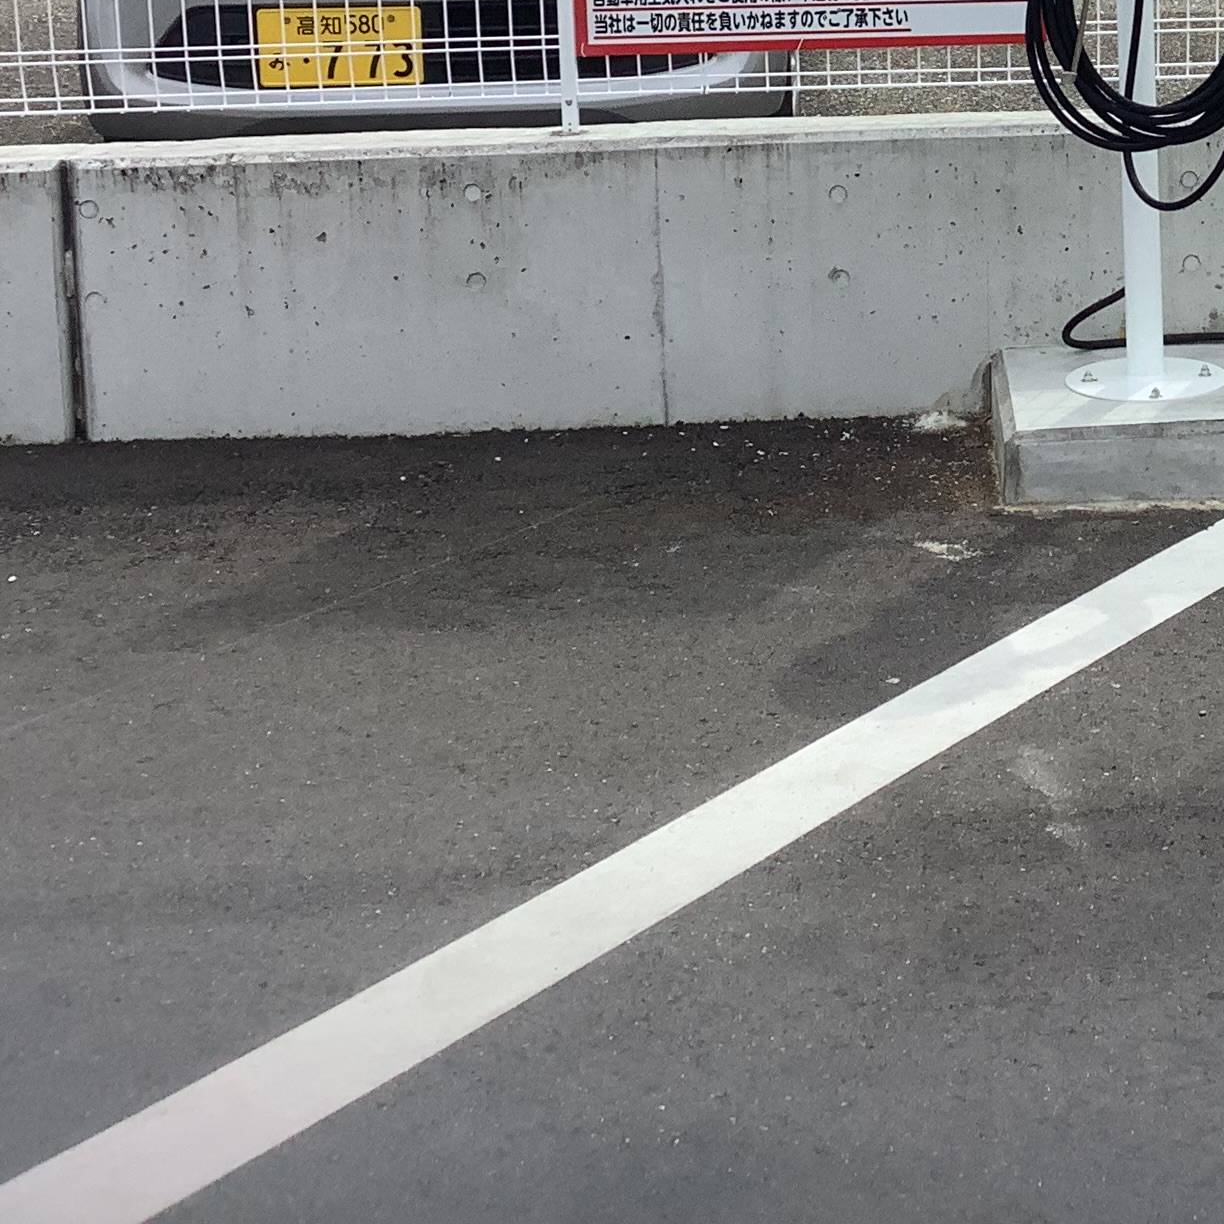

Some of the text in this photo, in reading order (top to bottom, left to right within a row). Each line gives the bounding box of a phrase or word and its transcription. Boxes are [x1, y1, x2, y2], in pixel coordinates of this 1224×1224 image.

[594, 6, 911, 35] 当社は一切の責任を負いかねますのでご了承下さい
